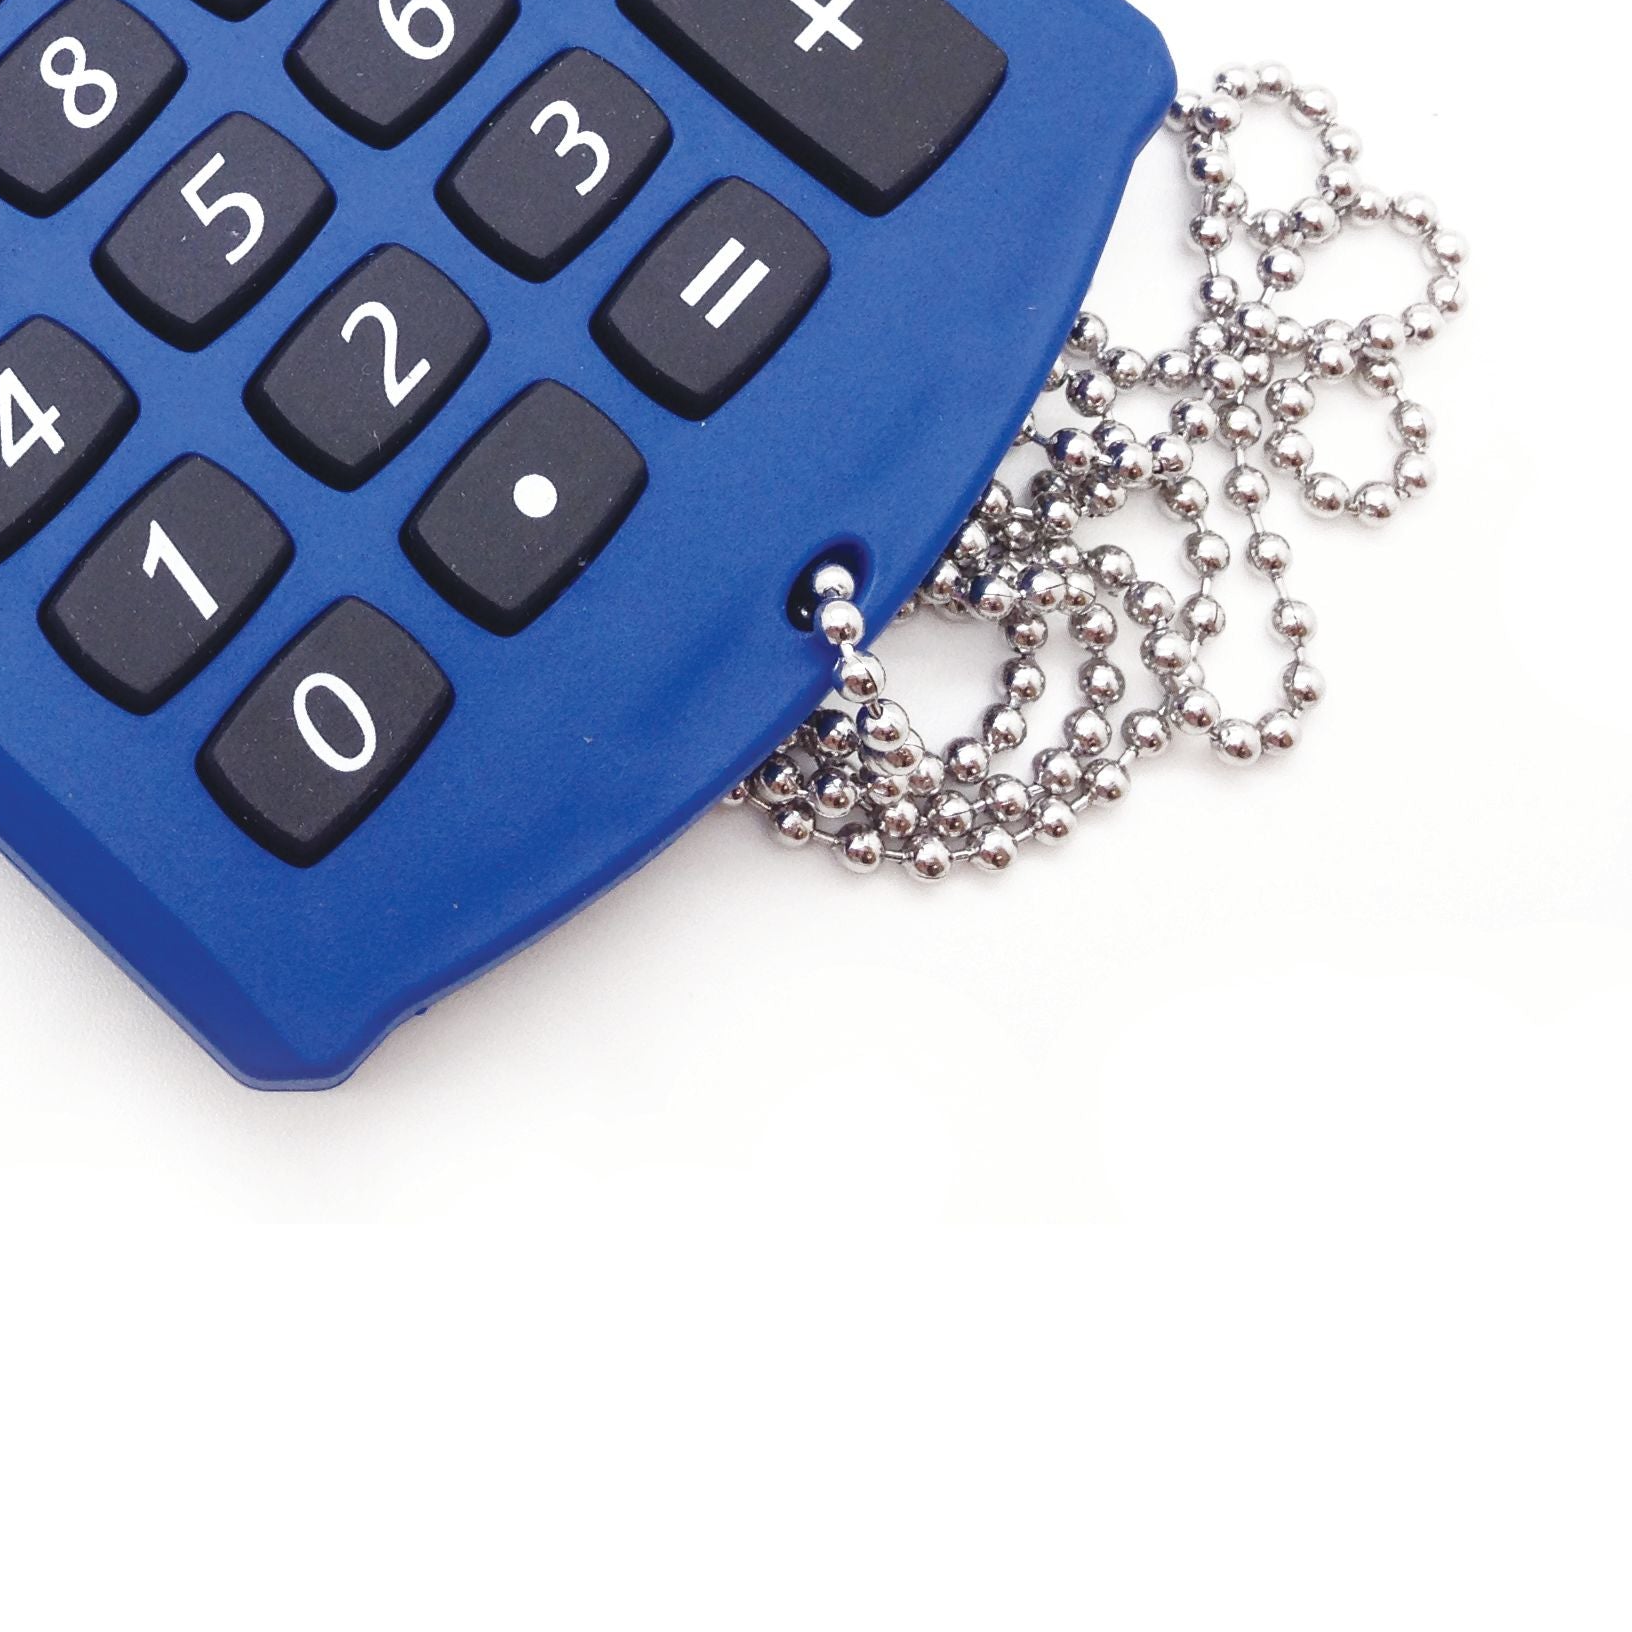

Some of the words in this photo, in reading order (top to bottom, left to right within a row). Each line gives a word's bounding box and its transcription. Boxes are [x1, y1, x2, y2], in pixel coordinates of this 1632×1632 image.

[39, 36, 118, 129] 8
[529, 99, 611, 197] 3
[180, 152, 265, 266] 5
[340, 300, 431, 408] 2
[142, 519, 219, 621] 1
[292, 672, 377, 773] 0
